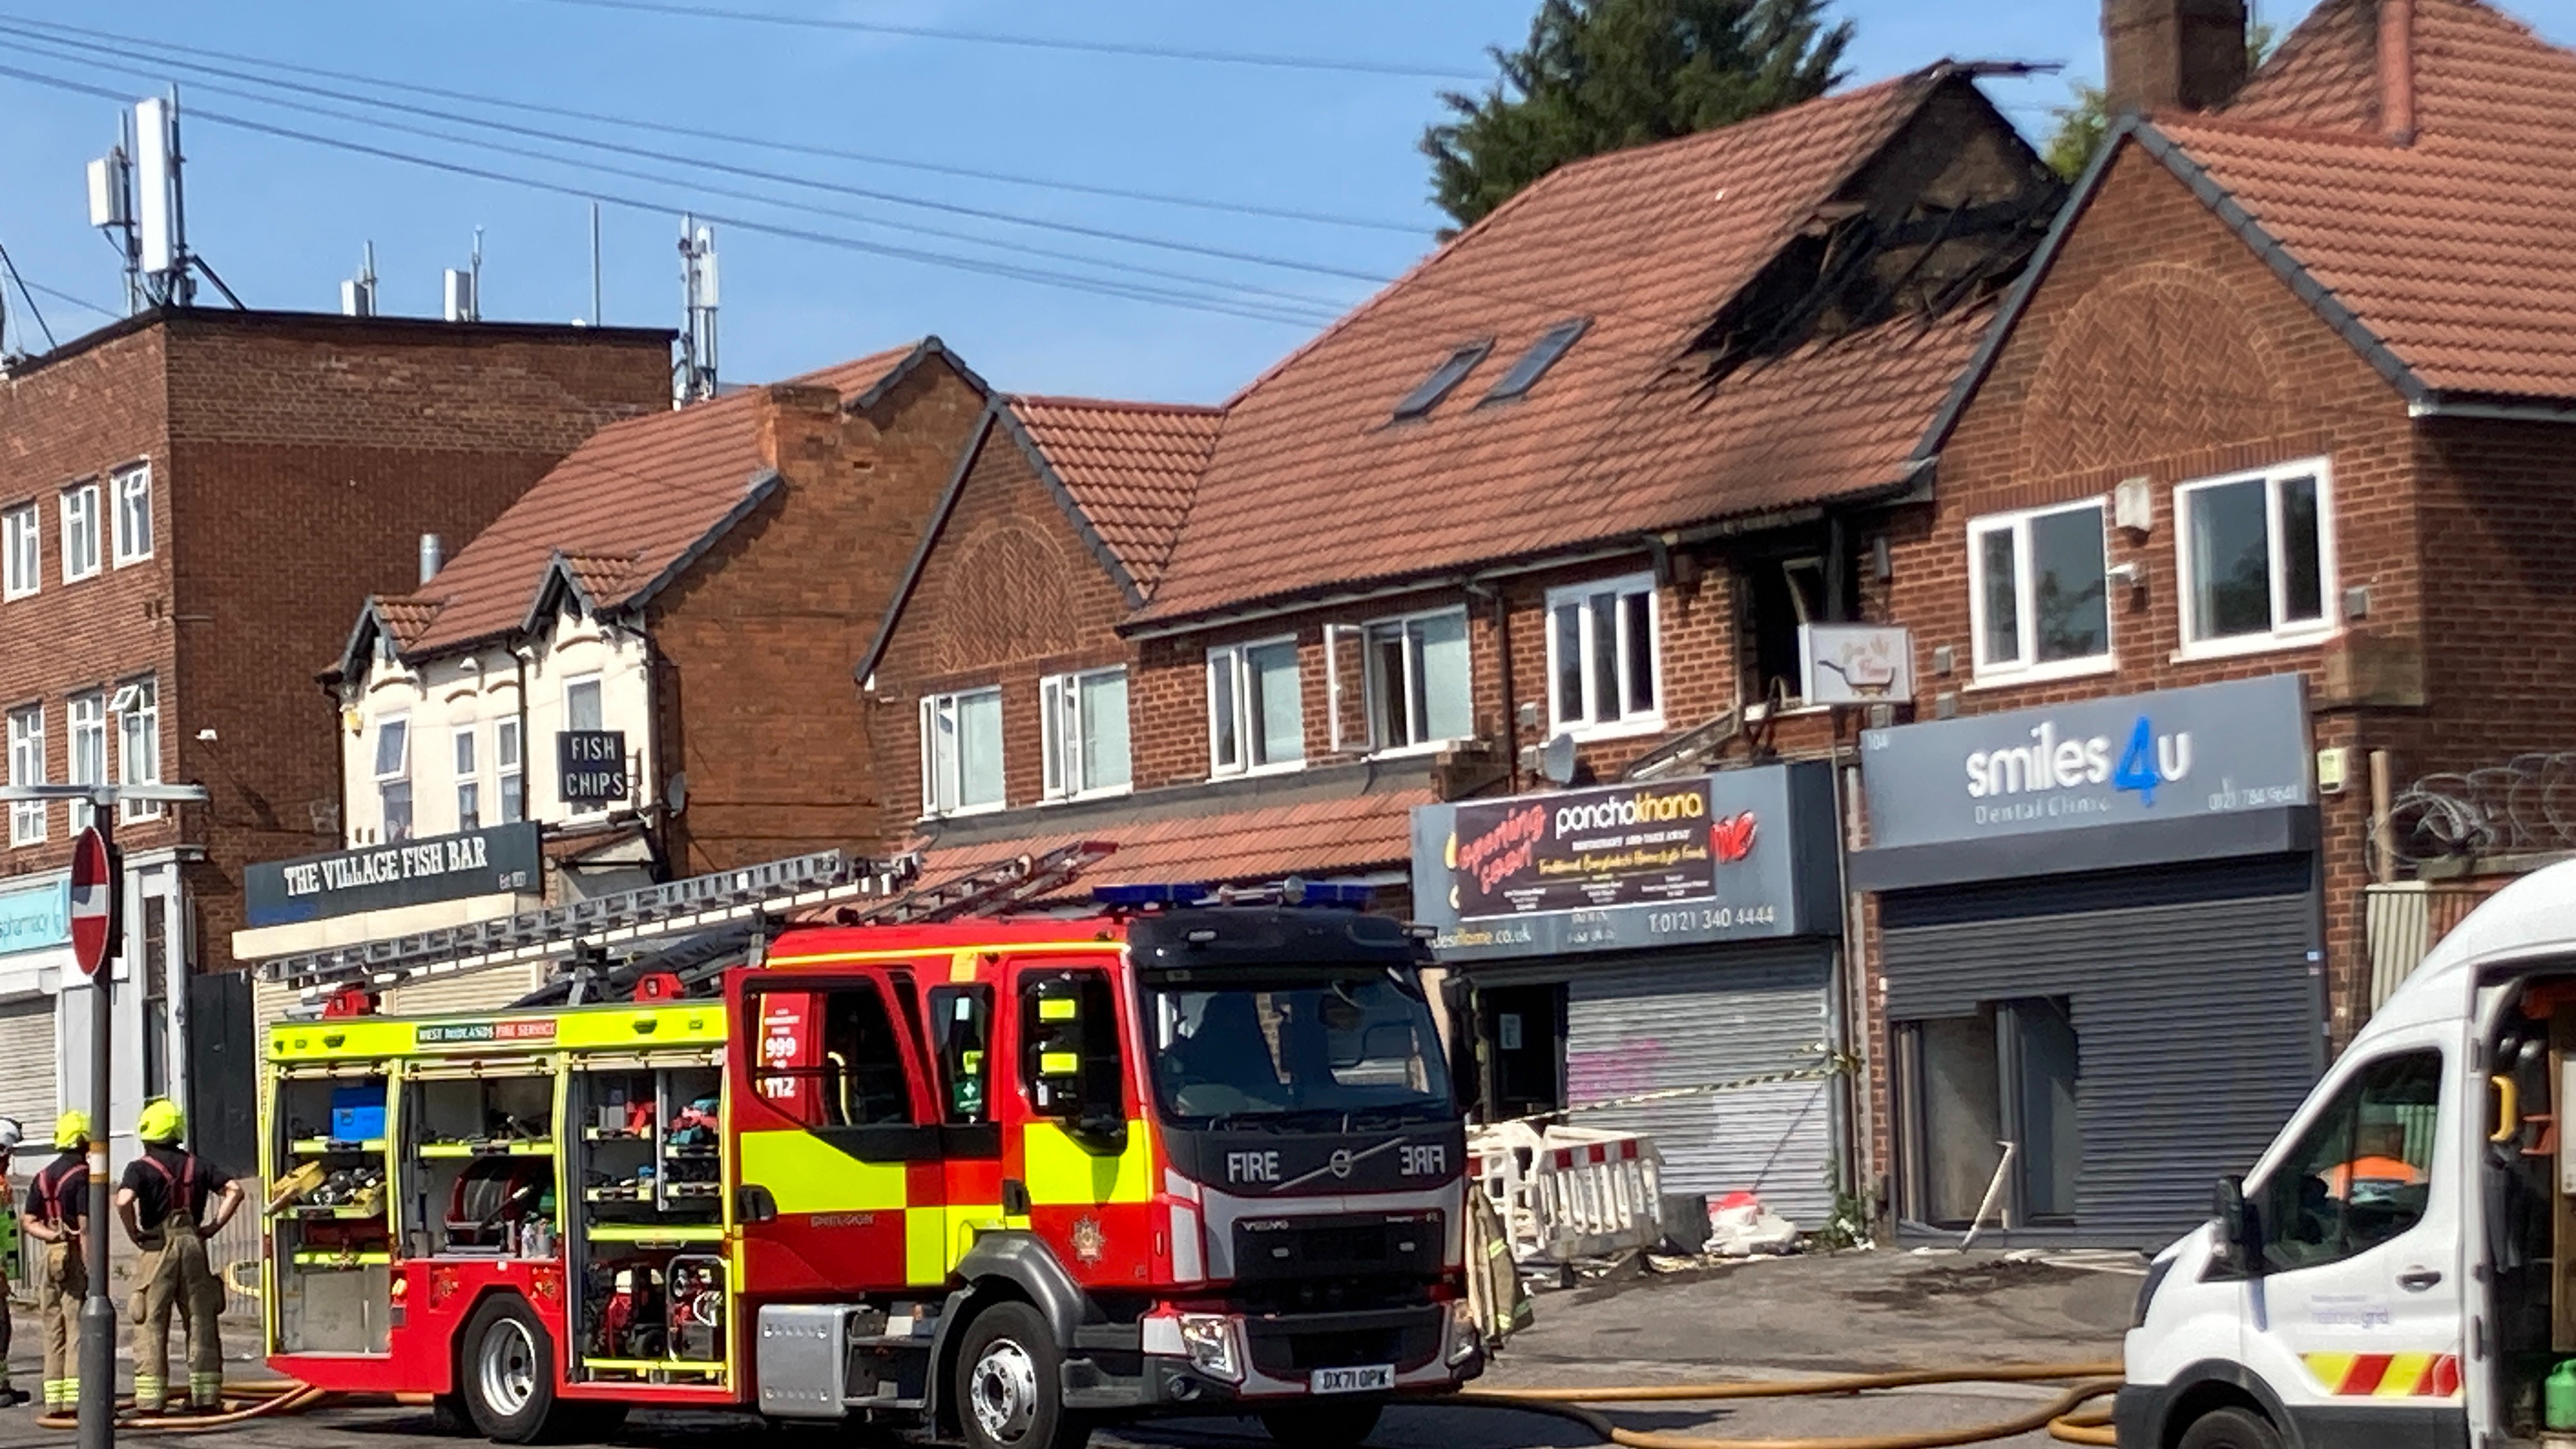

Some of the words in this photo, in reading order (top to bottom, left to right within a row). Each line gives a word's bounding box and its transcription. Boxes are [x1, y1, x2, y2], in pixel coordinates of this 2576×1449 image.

[572, 737, 615, 760] FISH
[565, 772, 624, 796] CHIPS
[1975, 798, 2043, 825] Dental
[2047, 795, 2110, 817] Clinic
[284, 862, 320, 896] THE
[321, 850, 400, 891] VILLAGE
[401, 841, 445, 878] FISH
[446, 836, 488, 871] BAR
[1701, 907, 1731, 930] 340
[1735, 904, 1774, 926] 4444
[418, 1027, 443, 1041] WEST
[765, 1037, 797, 1058] 999
[764, 1076, 796, 1099] 112
[1227, 1151, 1280, 1183] FIRE
[1323, 1370, 1356, 1390] DX71
